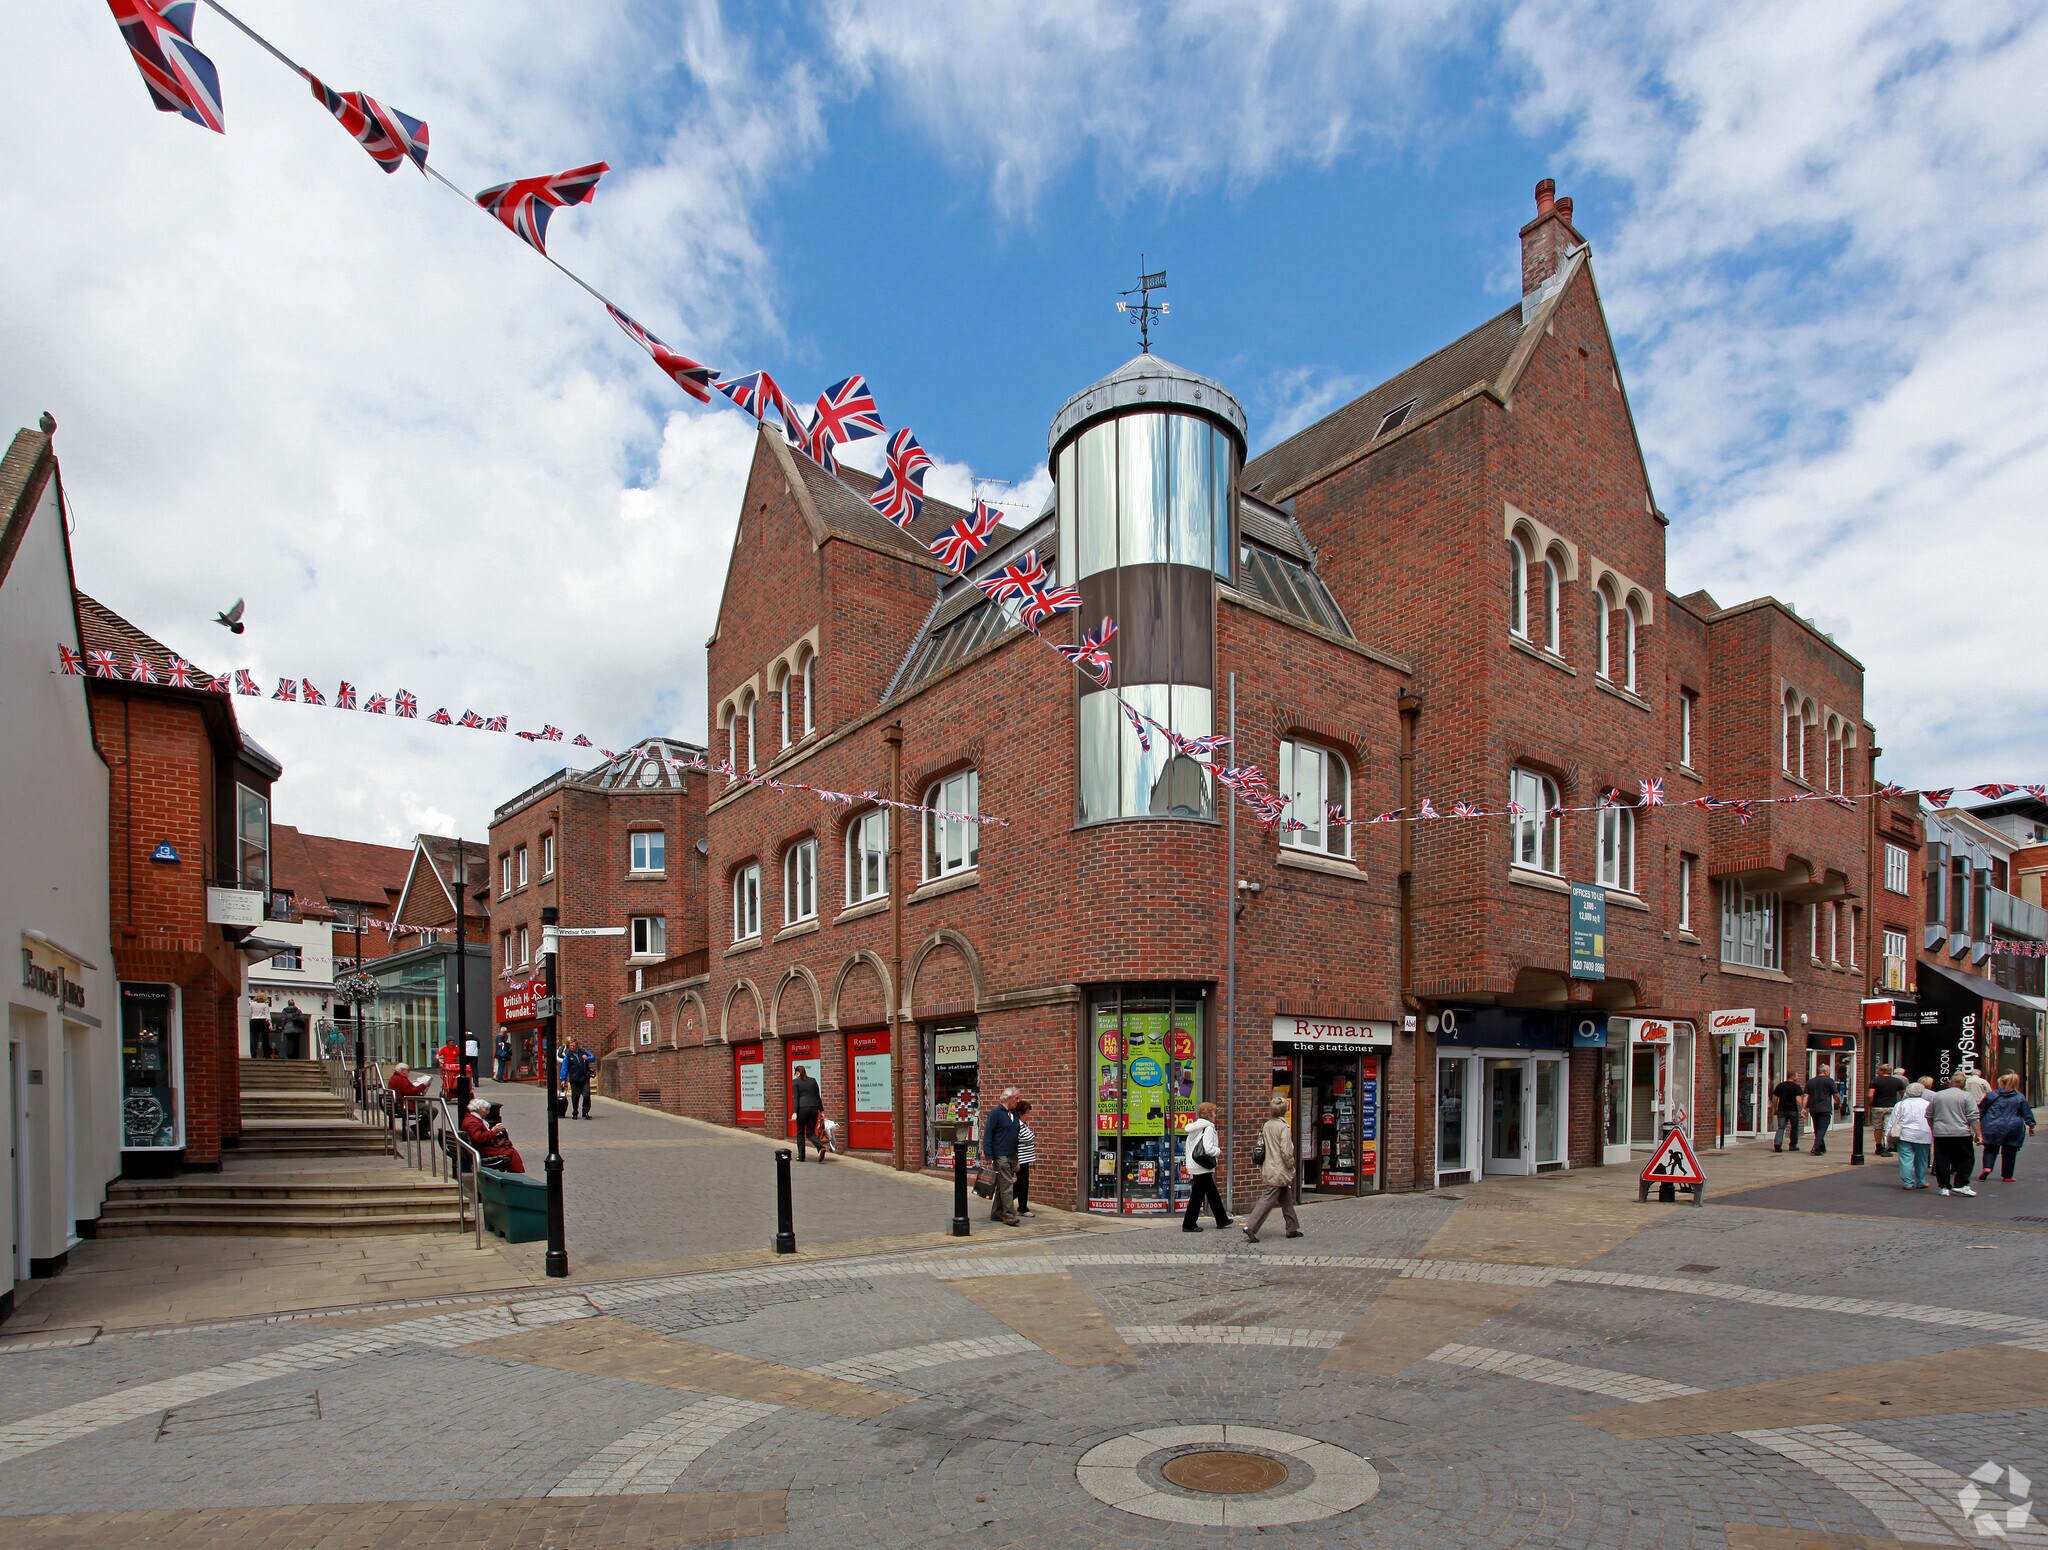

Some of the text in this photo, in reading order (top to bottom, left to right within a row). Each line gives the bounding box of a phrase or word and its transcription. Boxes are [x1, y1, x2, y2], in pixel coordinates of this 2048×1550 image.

[1147, 275, 1165, 288] 1886
[1116, 302, 1126, 312] W
[1161, 303, 1170, 314] E
[1572, 887, 1591, 900] OFFICES
[1591, 890, 1597, 900] TO
[1572, 960, 1582, 970] 020
[1583, 960, 1594, 972] 7409
[503, 994, 522, 1008] British
[505, 1005, 534, 1019] Foundat
[1406, 1020, 1416, 1028] Abel
[1714, 1016, 1750, 1028] Clinton
[1294, 1020, 1374, 1039] Ryman
[937, 1043, 975, 1055] Ryman
[1183, 1039, 1191, 1053] 2
[1294, 1042, 1374, 1052] the stationer
[1958, 1013, 1978, 1078] dryStore.
[1940, 1050, 1950, 1075] SOON
